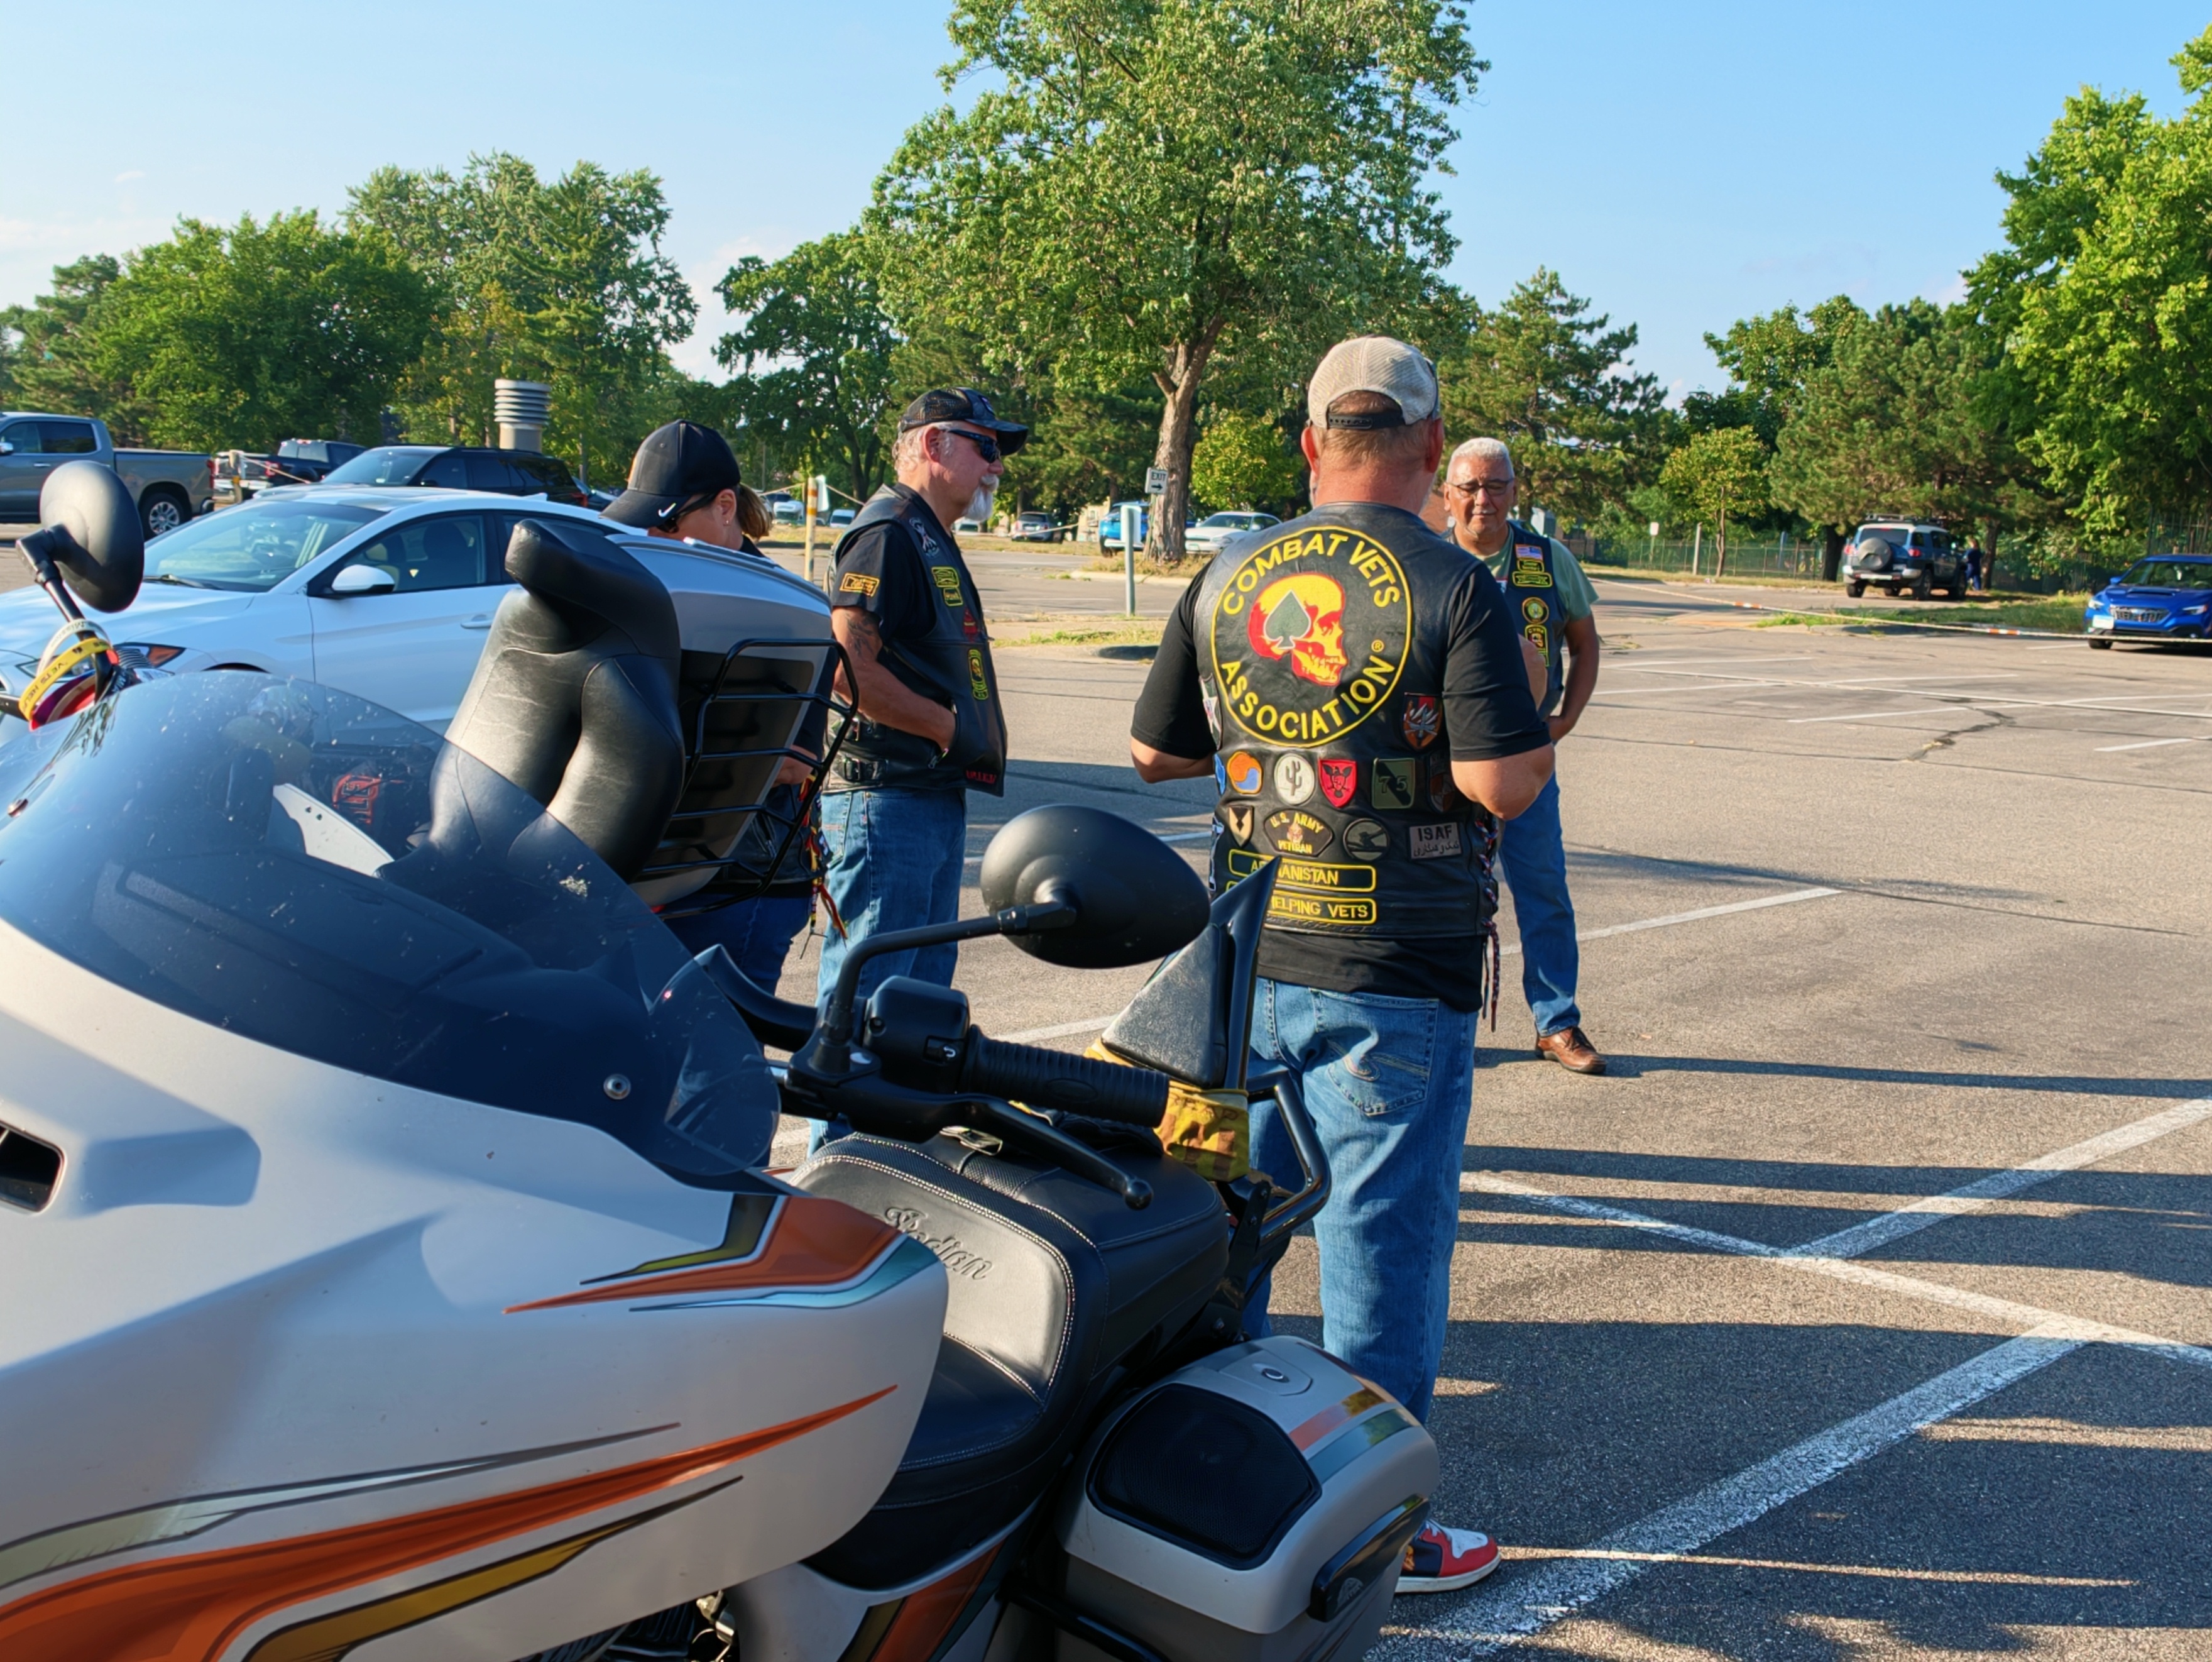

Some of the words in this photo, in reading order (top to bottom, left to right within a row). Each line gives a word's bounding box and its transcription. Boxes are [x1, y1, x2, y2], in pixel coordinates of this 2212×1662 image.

[1151, 471, 1166, 482] EXIT
[1222, 532, 1348, 615] COMBAT
[1349, 540, 1401, 607] VETS
[1378, 775, 1408, 793] 75
[1293, 812, 1325, 834] ARMY
[1417, 825, 1452, 842] ISAF
[1277, 840, 1313, 854] VETERAN
[1327, 903, 1368, 918] VETS
